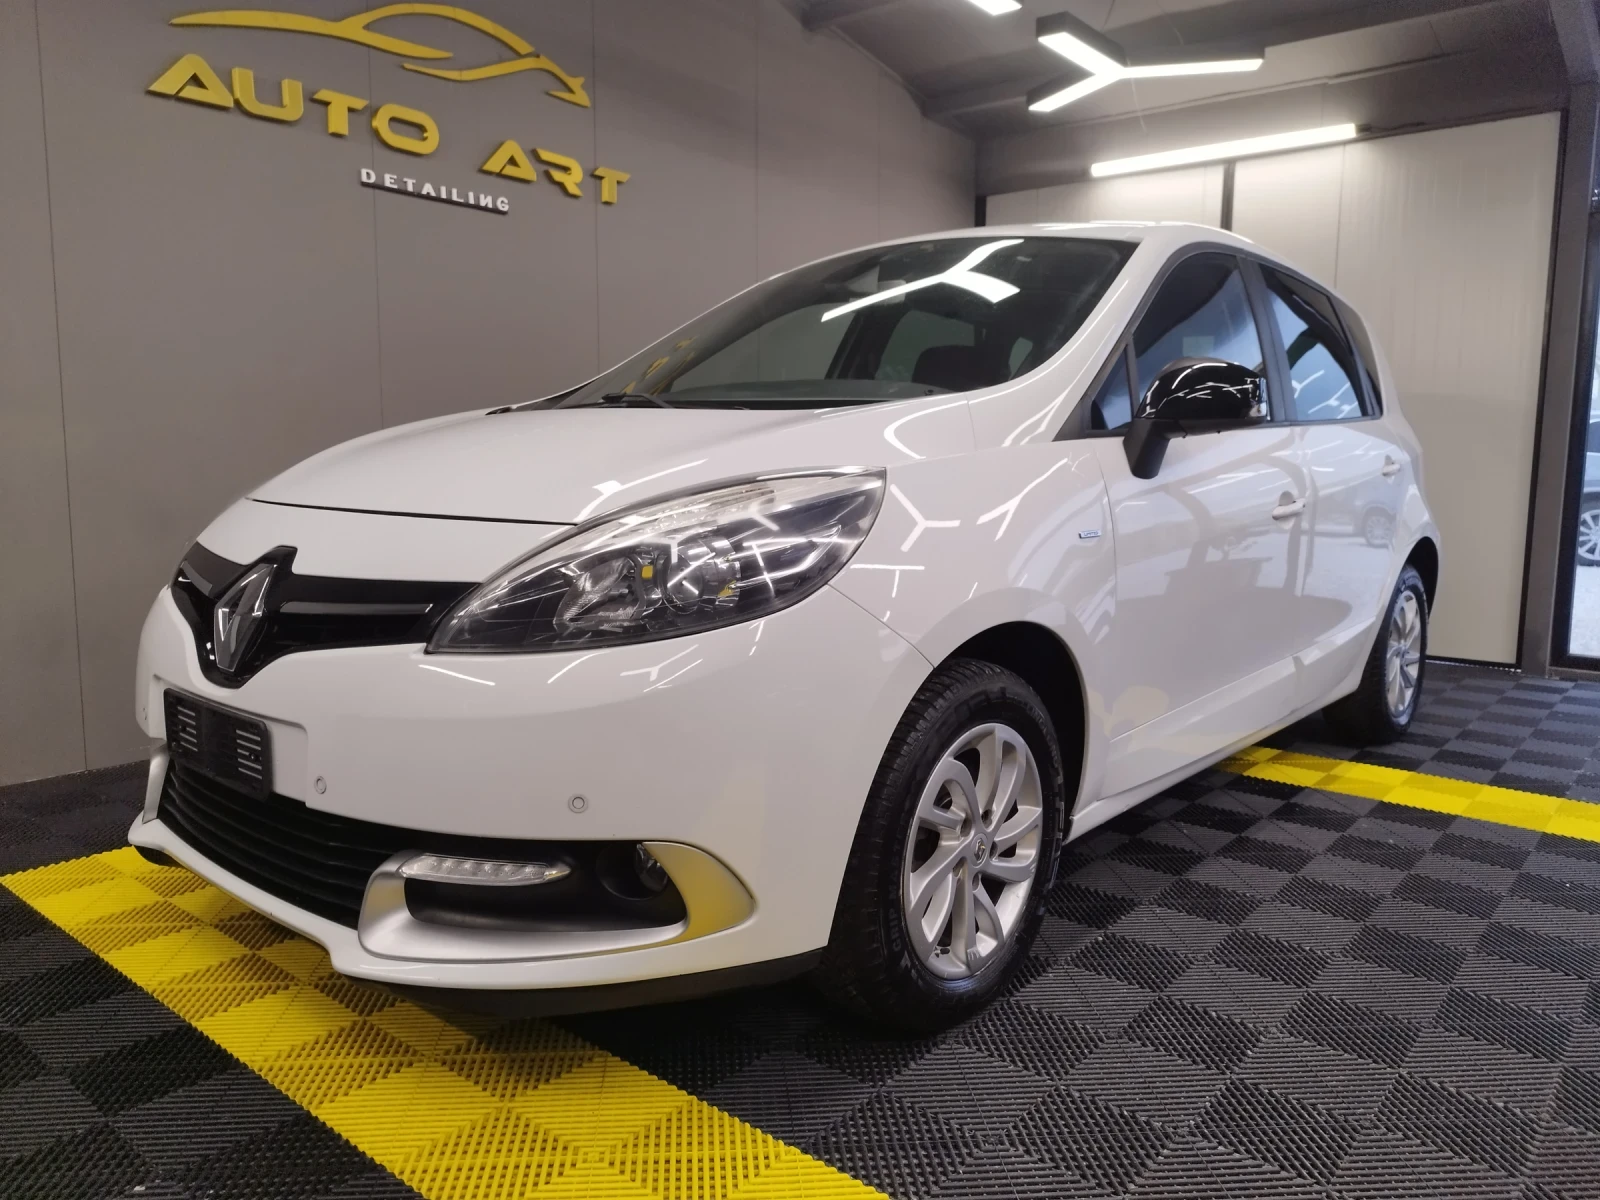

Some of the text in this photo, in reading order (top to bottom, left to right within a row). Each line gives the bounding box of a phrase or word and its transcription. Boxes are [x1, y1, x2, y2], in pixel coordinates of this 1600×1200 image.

[147, 53, 631, 205] AUTO ART
[360, 168, 511, 212] DETAILING
